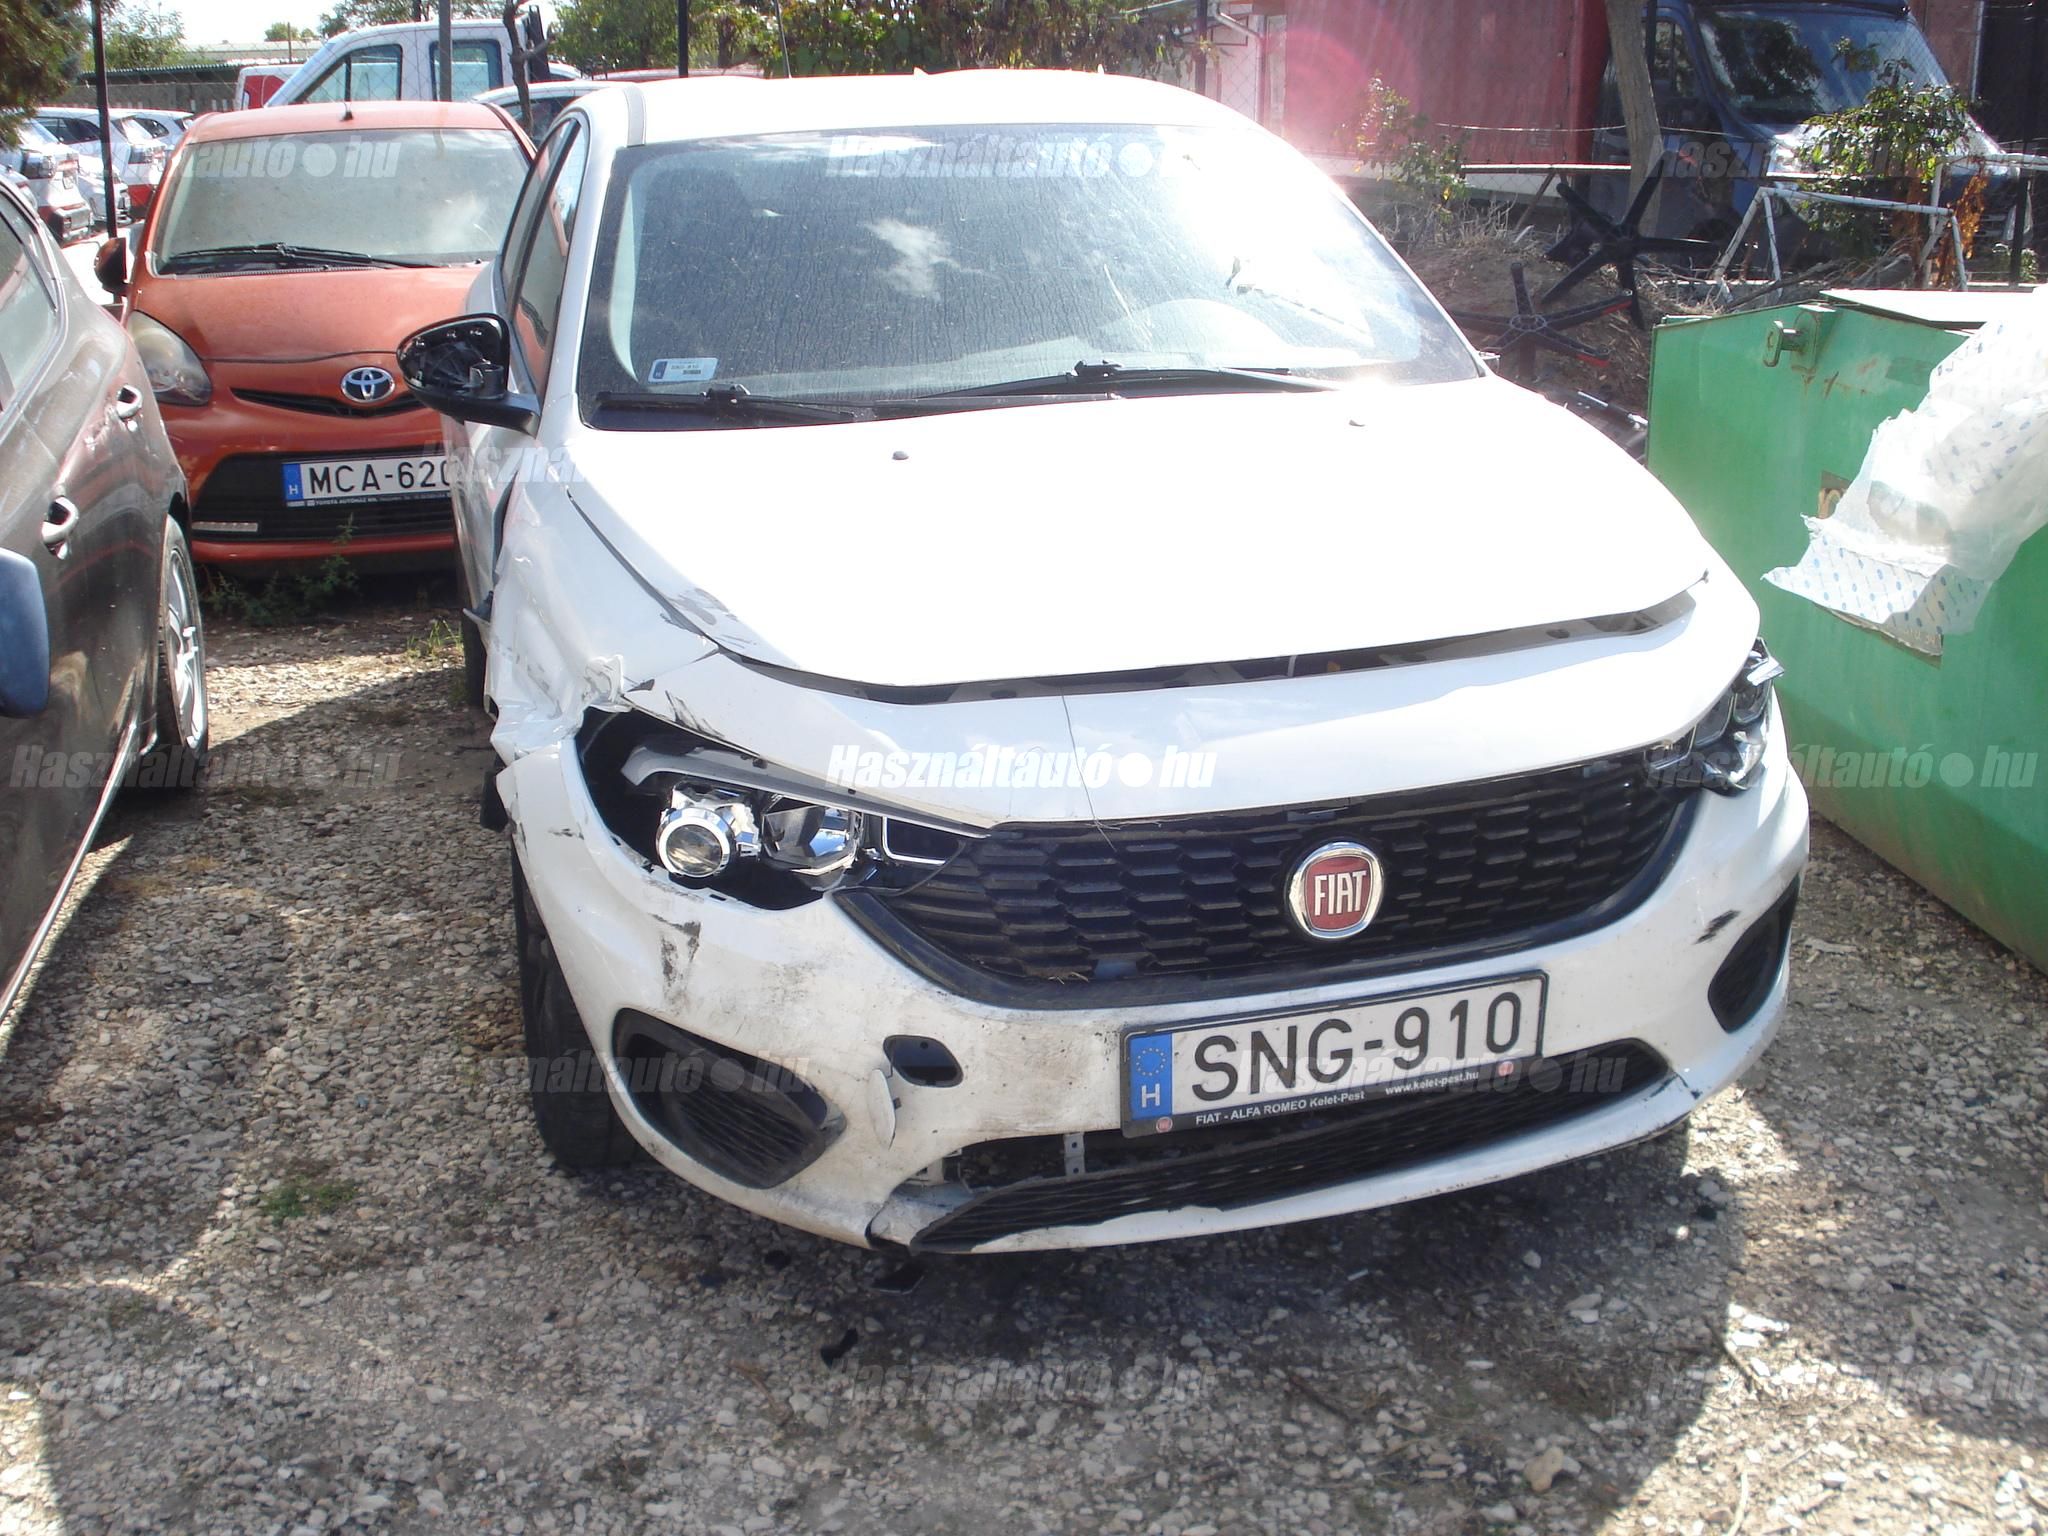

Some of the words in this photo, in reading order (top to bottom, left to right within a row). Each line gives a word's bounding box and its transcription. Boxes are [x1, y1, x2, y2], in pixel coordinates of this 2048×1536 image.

[288, 484, 299, 496] H
[1314, 870, 1367, 917] FIAT
[1191, 991, 1522, 1102] SNG-910
[1141, 1083, 1161, 1109] H
[1385, 1070, 1480, 1096] www.kelet-pest.hu
[1195, 1112, 1222, 1126] FIAT
[1230, 1106, 1261, 1121] ALFA
[1263, 1099, 1307, 1115] ROMEO
[1309, 1090, 1365, 1108] Kelet-Pest
